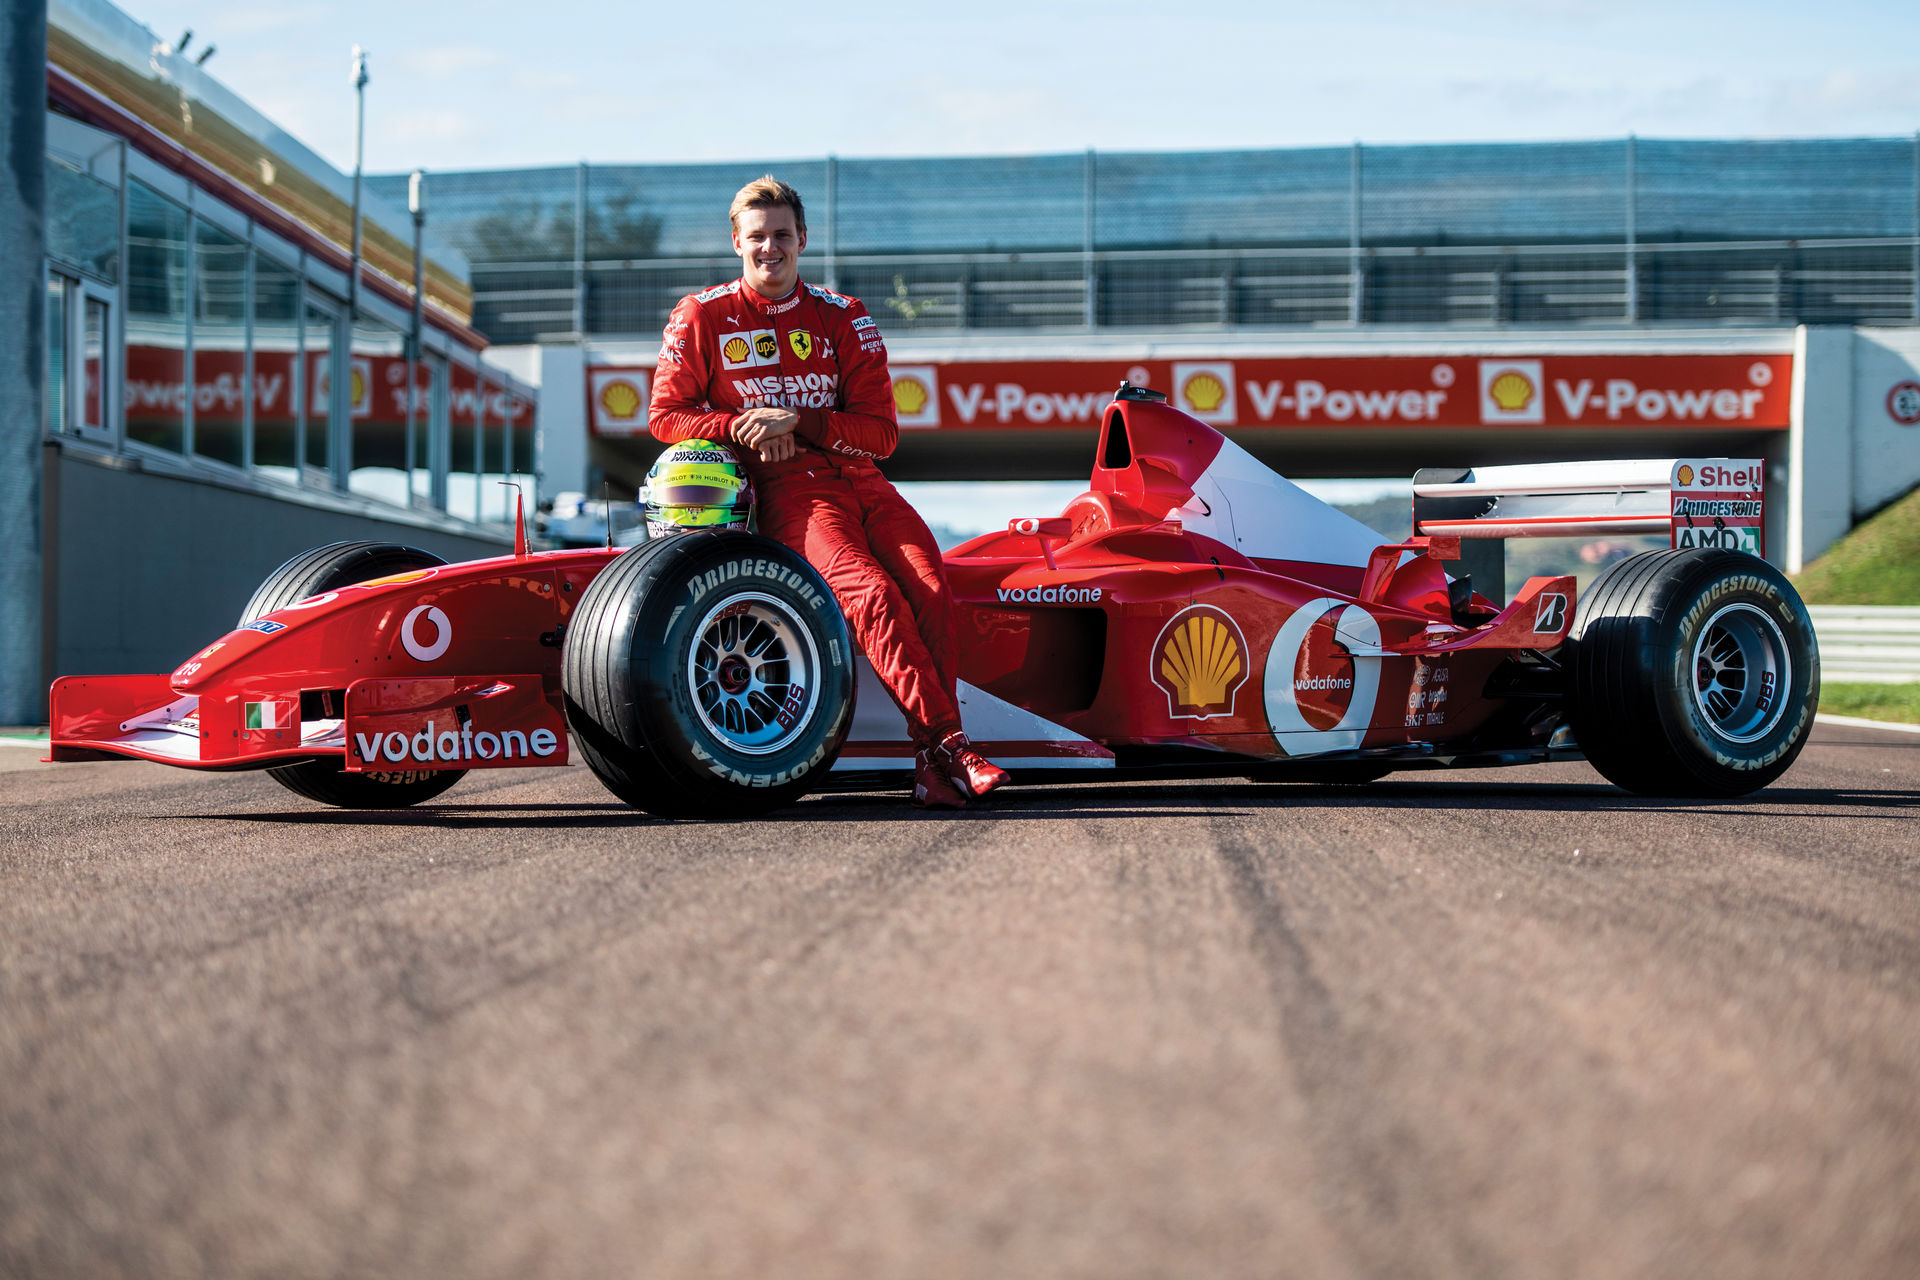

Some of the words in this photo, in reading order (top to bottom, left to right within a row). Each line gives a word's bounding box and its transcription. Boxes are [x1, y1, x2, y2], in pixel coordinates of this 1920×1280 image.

[756, 341, 776, 356] ups
[732, 372, 838, 397] MISSION
[1245, 380, 1448, 421] V-Power
[1554, 378, 1764, 420] V-Power
[704, 475, 729, 485] HUBLOT
[1700, 466, 1761, 486] Shell
[1673, 497, 1762, 517] BRIDGESTONE
[1680, 529, 1739, 550] AMD
[687, 558, 826, 611] BRIDGESTONE
[997, 584, 1102, 603] vodafone
[1678, 575, 1778, 641] BRIDGESTONE
[175, 662, 201, 676] 219
[1295, 676, 1351, 691] vodafone
[1755, 670, 1775, 713] BBS
[775, 683, 805, 730] BBS
[1404, 713, 1425, 727] SKF
[355, 719, 558, 763] vodafone
[1715, 704, 1809, 771] POTENZA
[690, 740, 826, 788] POTENZA
